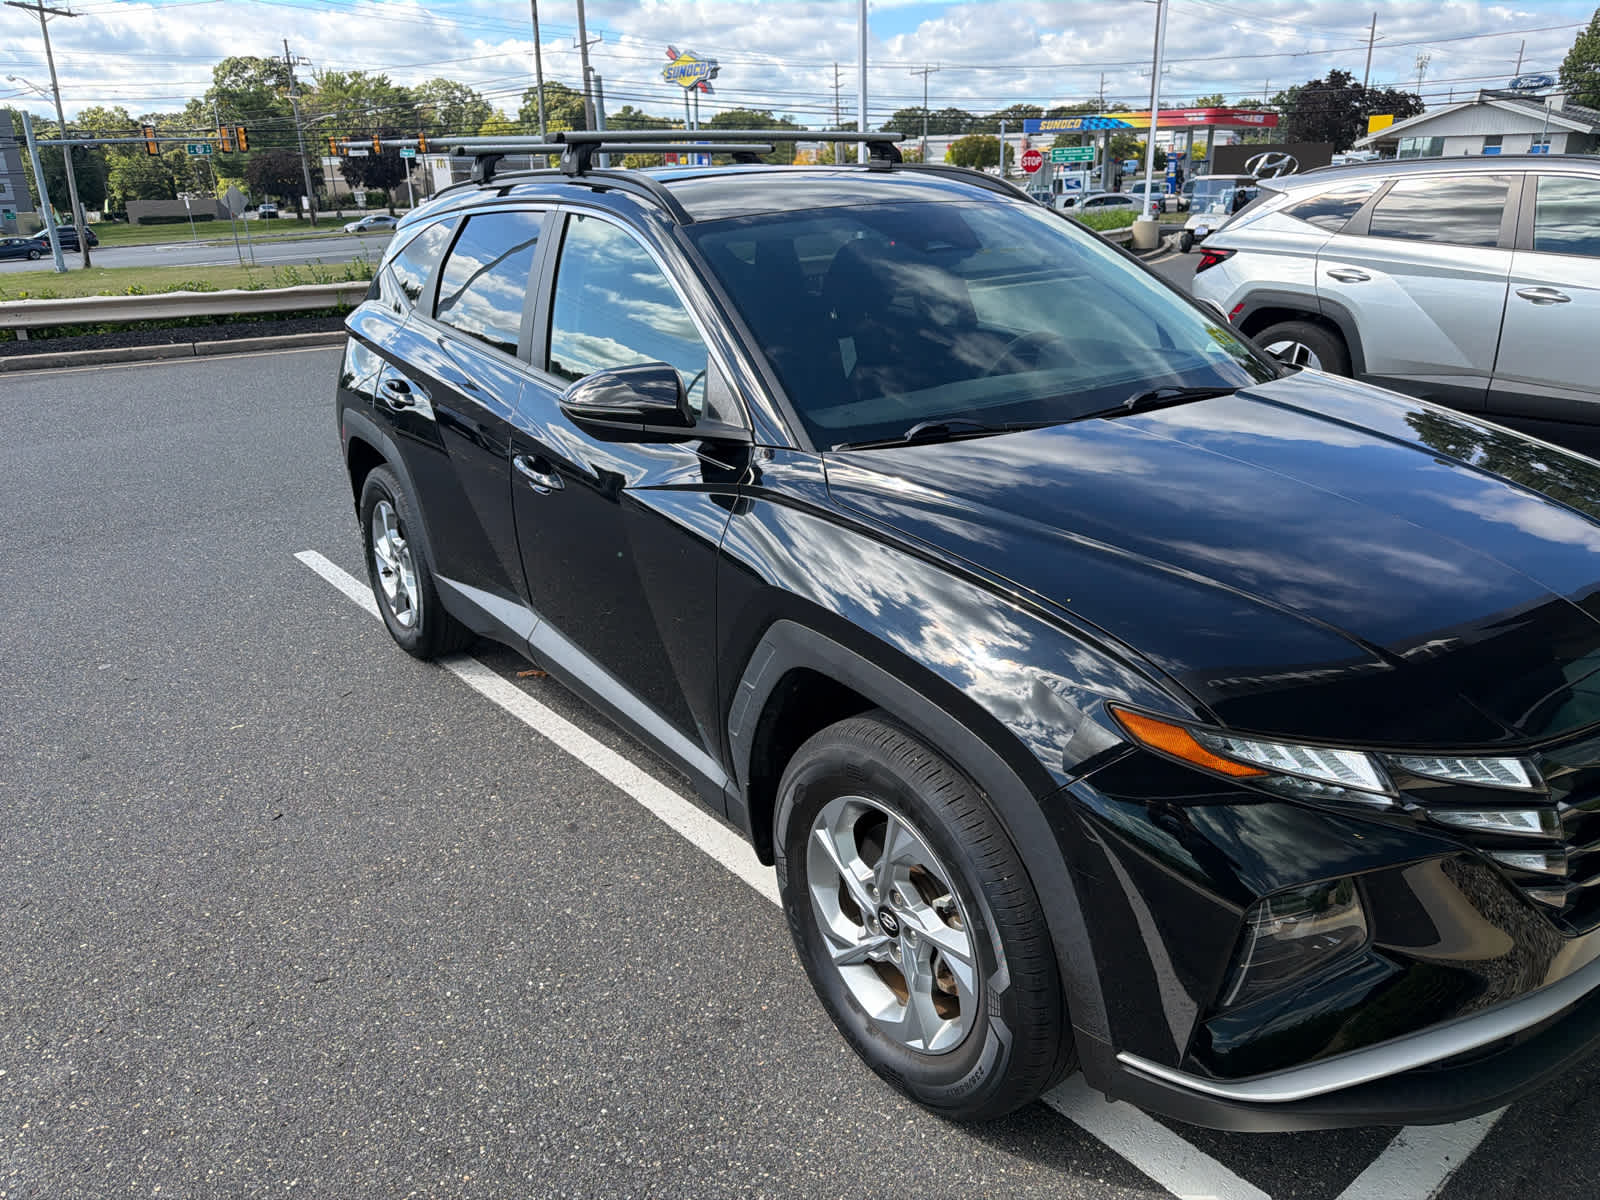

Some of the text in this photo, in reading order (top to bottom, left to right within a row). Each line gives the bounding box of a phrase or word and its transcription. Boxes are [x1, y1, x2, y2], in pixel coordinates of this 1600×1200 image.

[666, 63, 706, 79] SUNOCO
[1039, 118, 1082, 130] SUNOCO
[1022, 156, 1041, 166] STOP
